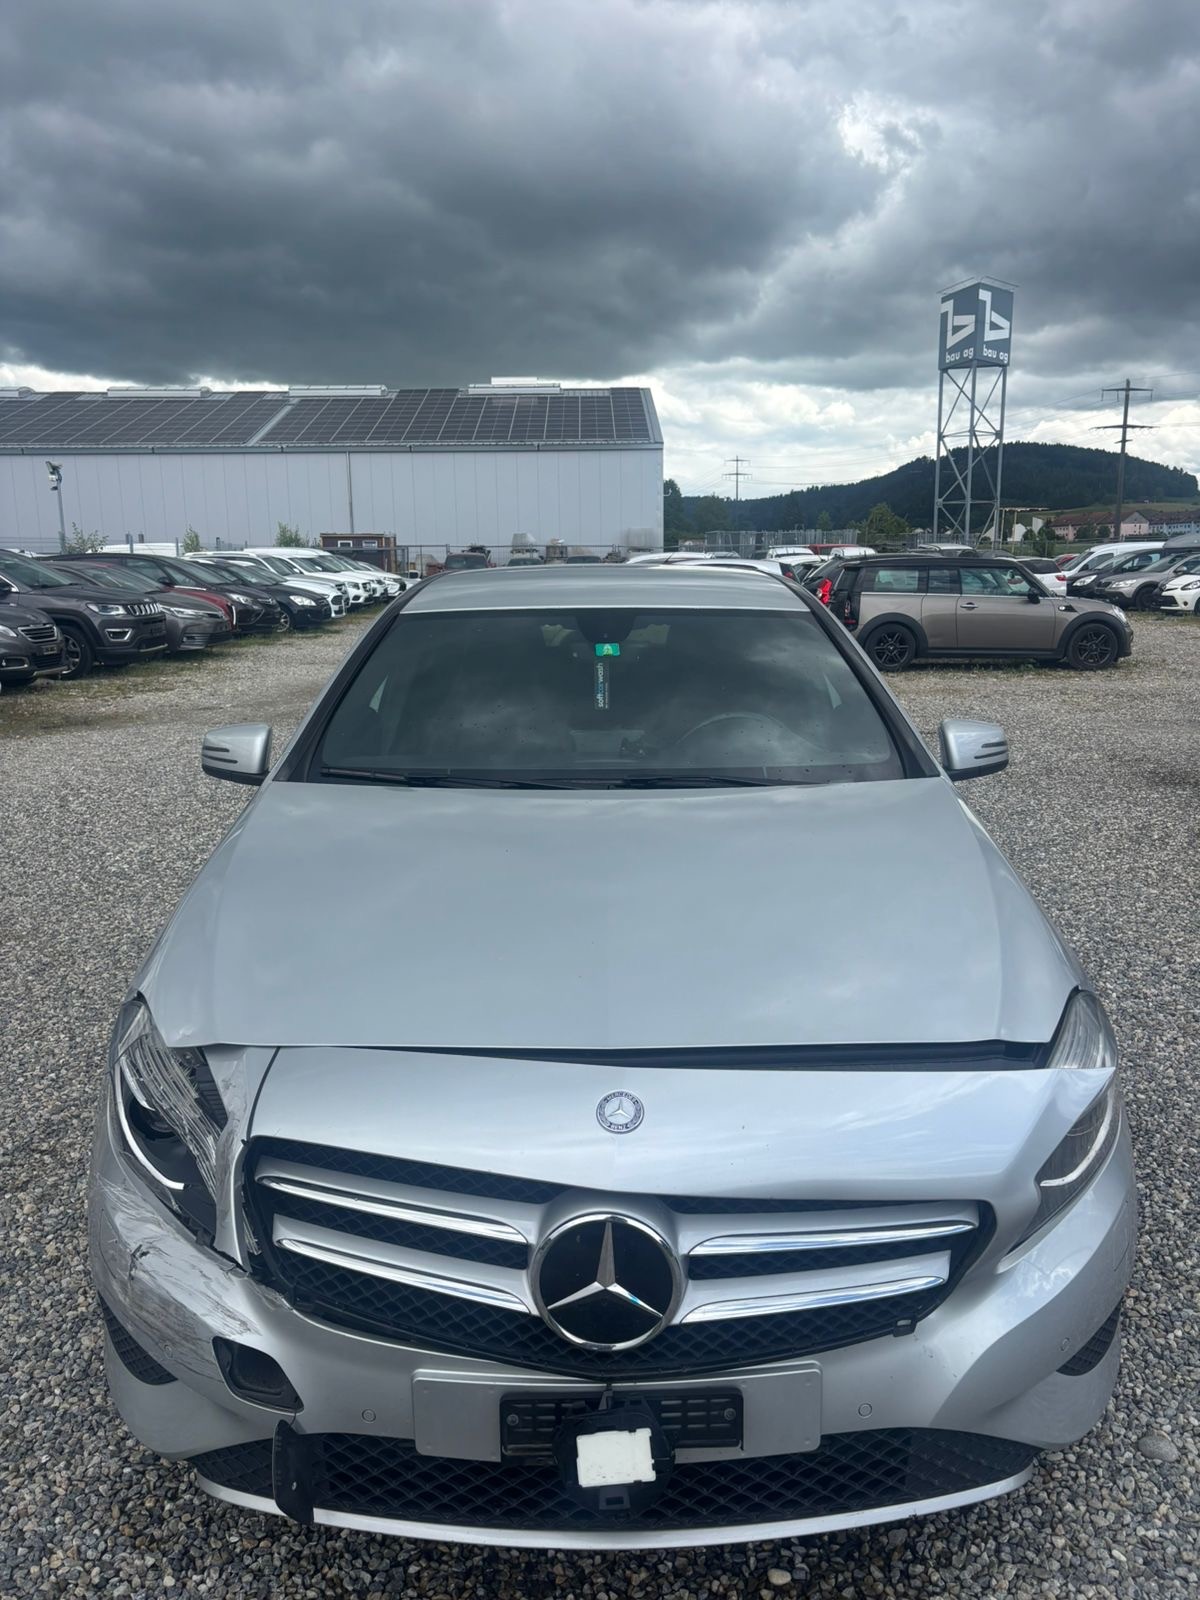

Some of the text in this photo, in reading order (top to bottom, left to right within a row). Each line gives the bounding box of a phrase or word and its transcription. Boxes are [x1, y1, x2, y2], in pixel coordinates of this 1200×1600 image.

[945, 347, 974, 363] bau ag
[983, 344, 1009, 364] bau ag
